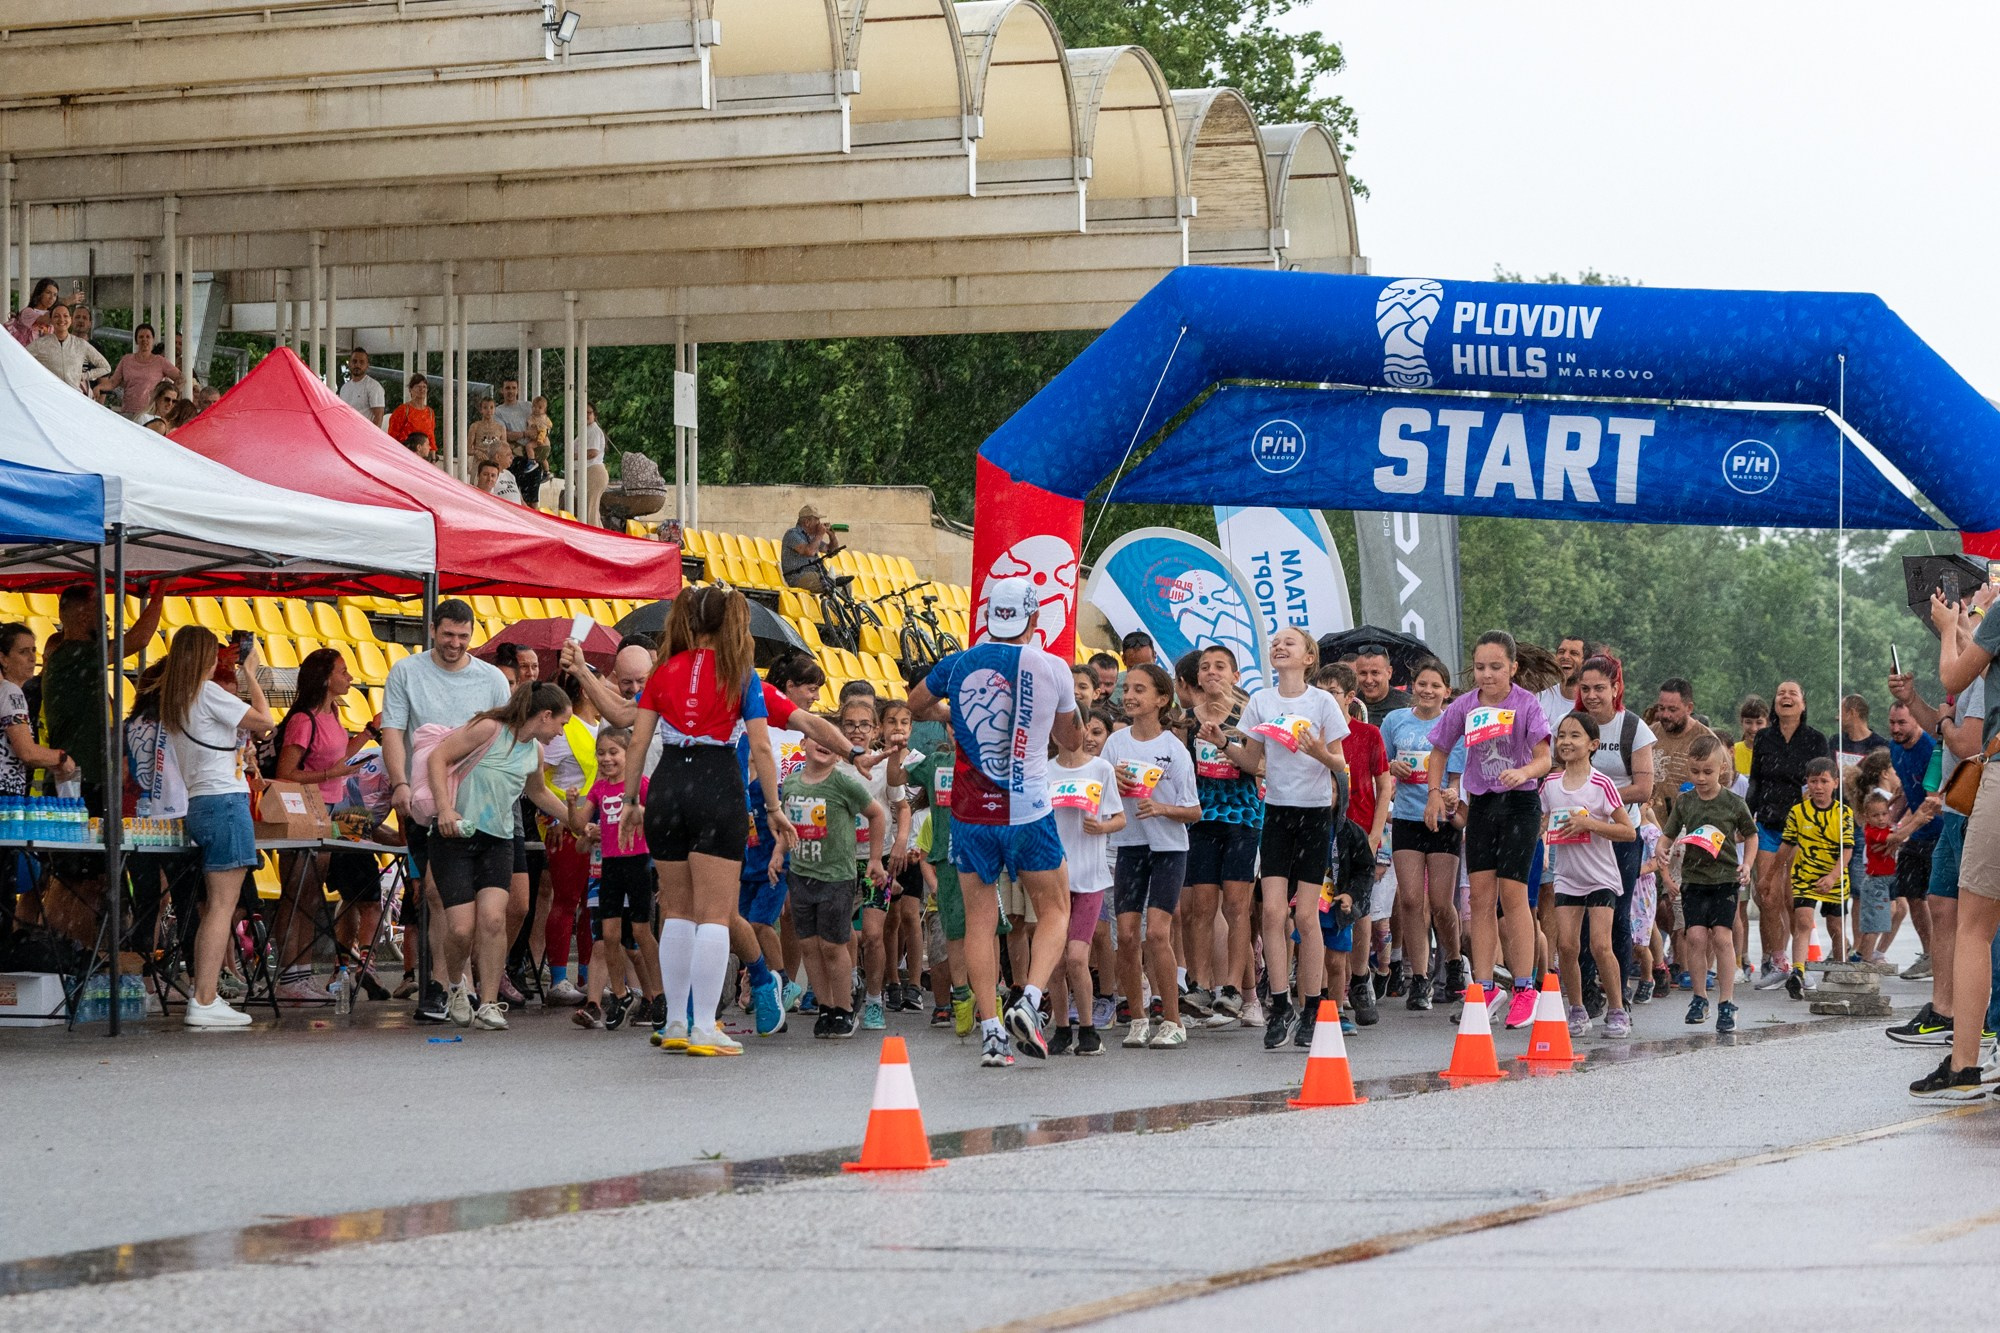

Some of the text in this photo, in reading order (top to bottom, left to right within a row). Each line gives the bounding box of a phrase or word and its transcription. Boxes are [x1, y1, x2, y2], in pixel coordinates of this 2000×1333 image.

[1452, 301, 1602, 339] PLOVDIV
[1452, 344, 1547, 378] HILLS
[1558, 353, 1576, 363] IN
[1559, 367, 1654, 380] MARKOVO
[1261, 436, 1296, 454] P/H
[1373, 407, 1656, 504] START
[1732, 455, 1770, 473] P/H
[1473, 712, 1490, 727] 97
[1012, 670, 1033, 794] EVERY STEP MATTERS
[156, 748, 165, 772] STEP
[153, 772, 163, 800] EVERY
[1056, 783, 1077, 794] 46
